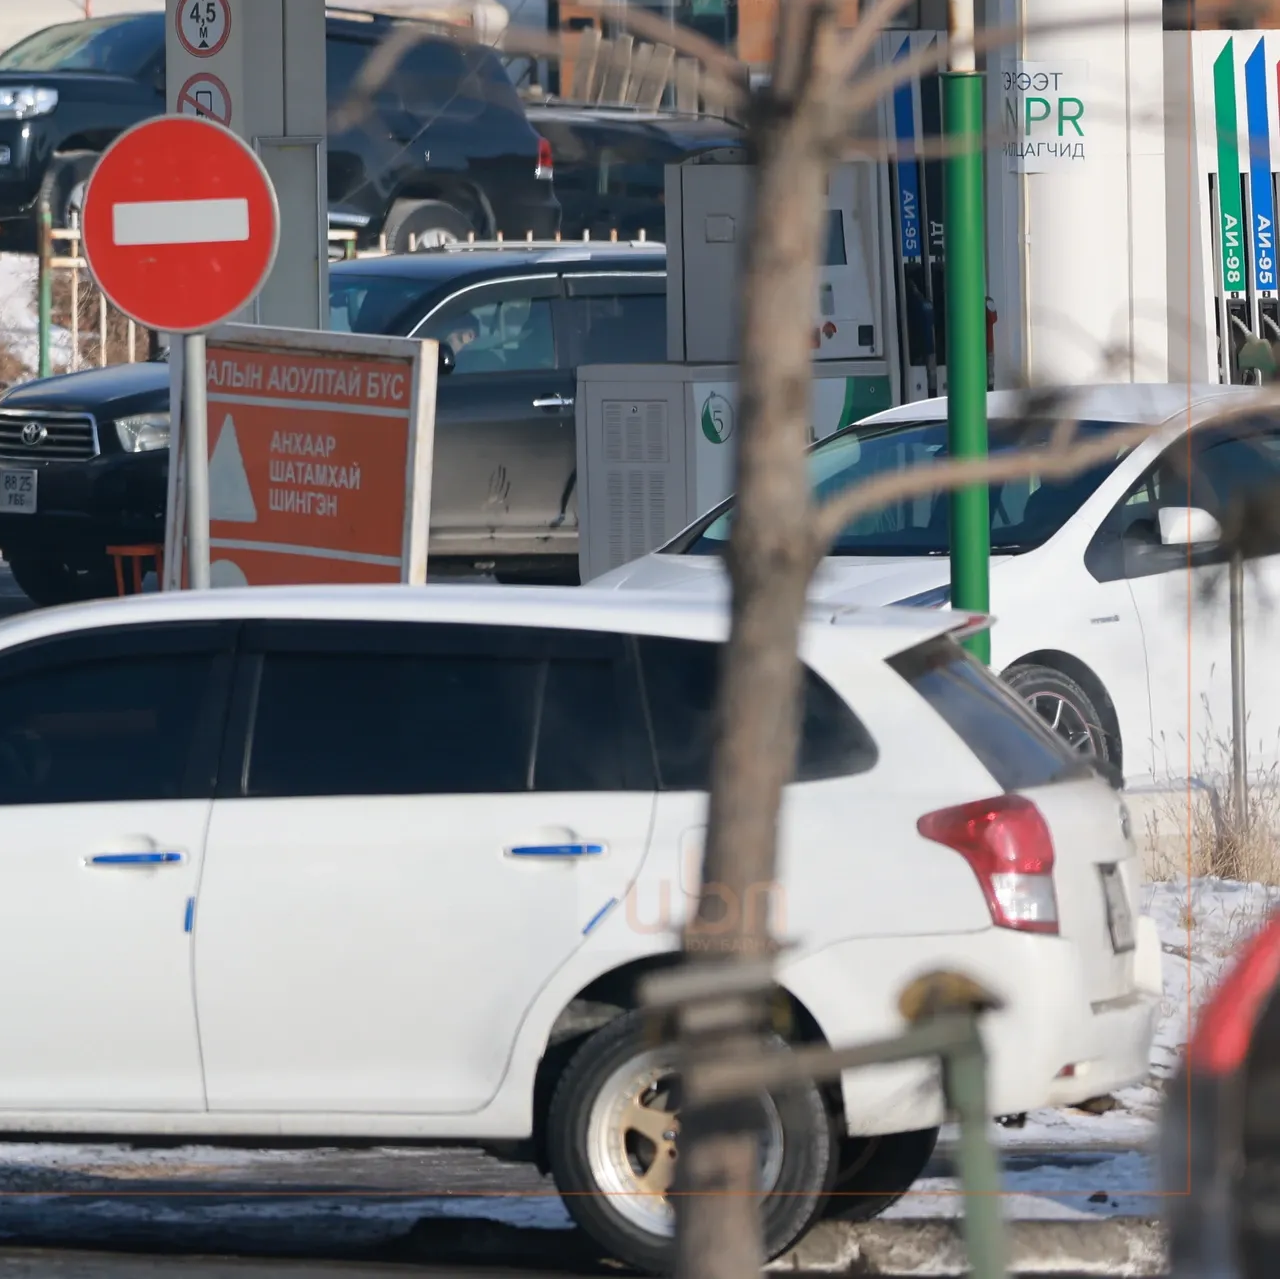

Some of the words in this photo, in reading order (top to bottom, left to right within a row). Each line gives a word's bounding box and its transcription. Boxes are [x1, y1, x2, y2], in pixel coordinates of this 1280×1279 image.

[190, 2, 216, 27] 4,5
[1002, 72, 1063, 91] ЭРЭЭТ
[902, 190, 917, 250] АИ-95
[1224, 213, 1241, 283] АИ-98
[1257, 214, 1273, 284] АИ-95
[206, 359, 262, 390] АЛЫН
[267, 364, 362, 398] АЮУЛТАЙ
[366, 372, 405, 401] БҮС
[270, 430, 336, 458] АНХААР
[269, 459, 361, 489] ШАТАМХАЙ
[269, 488, 338, 517] ШИНГЭН
